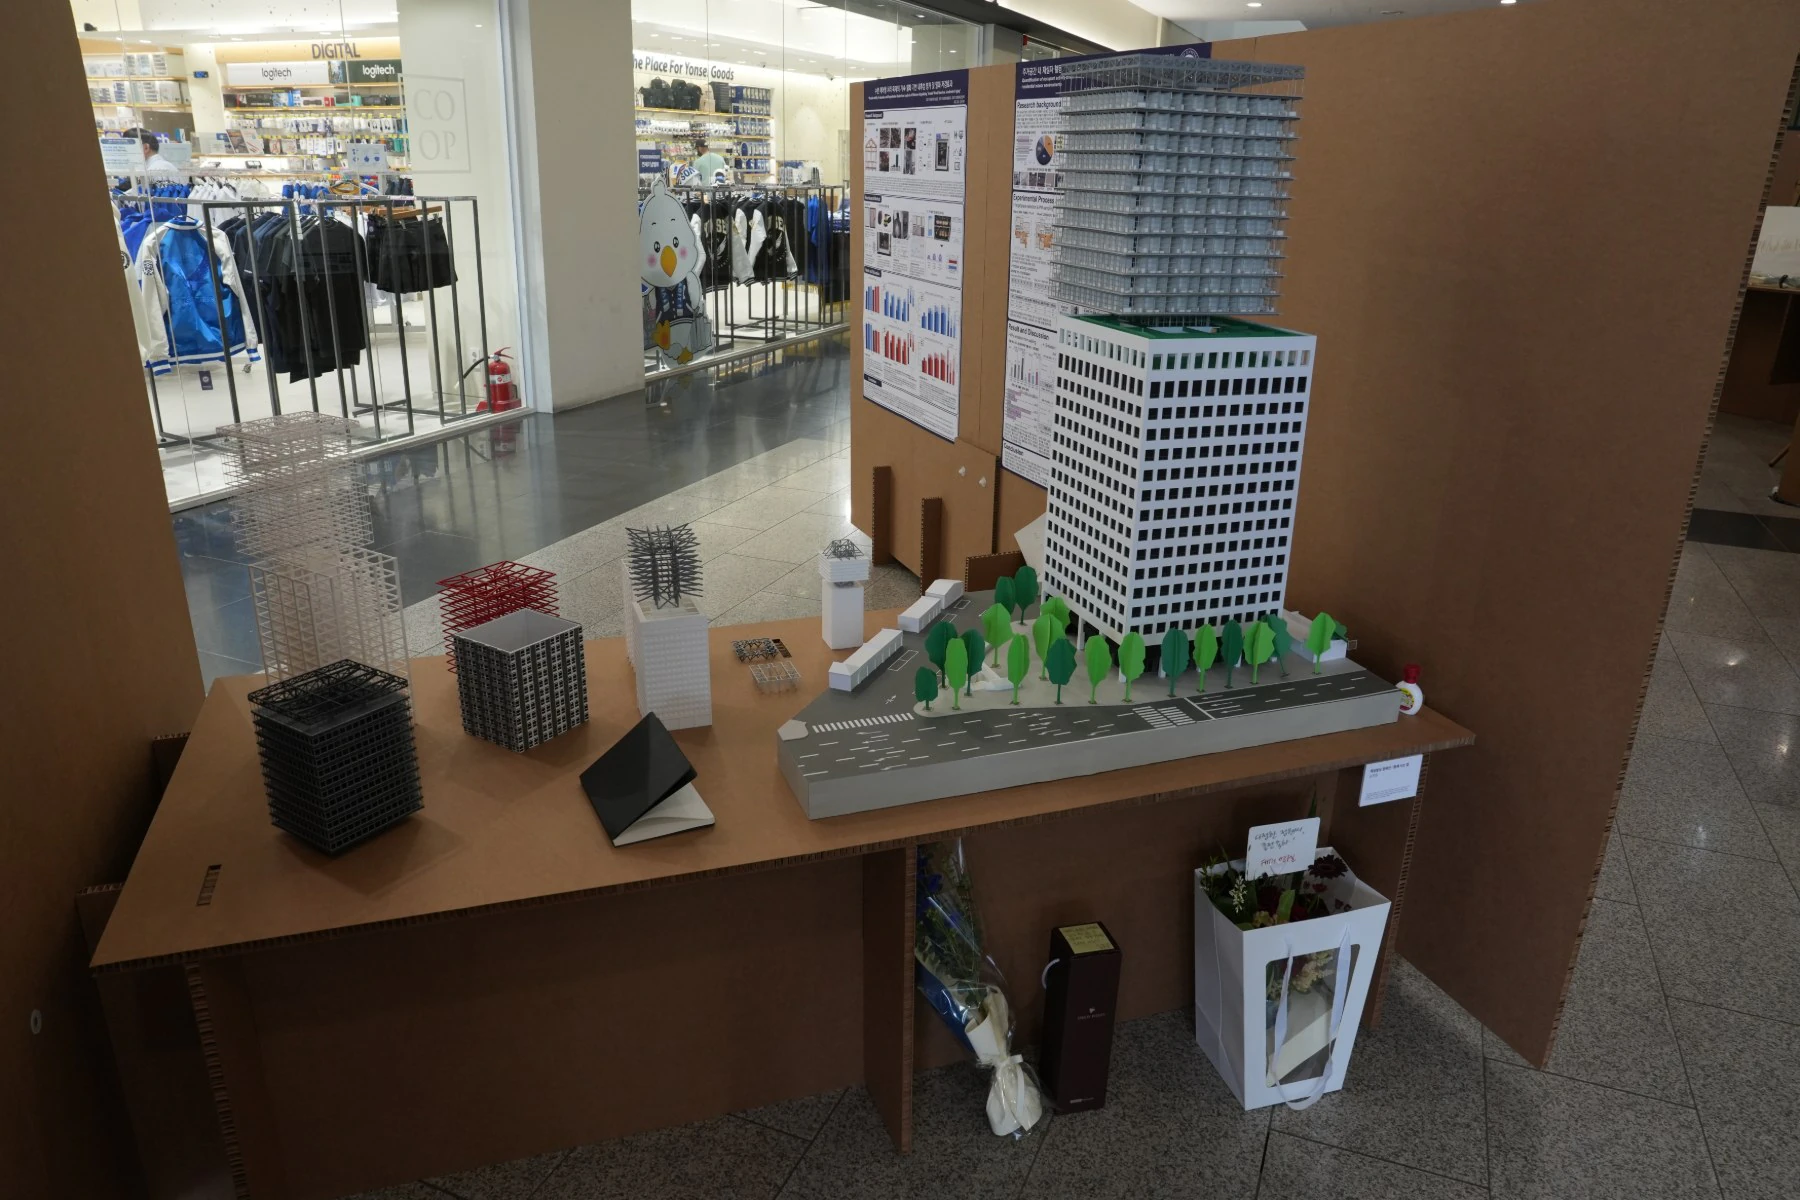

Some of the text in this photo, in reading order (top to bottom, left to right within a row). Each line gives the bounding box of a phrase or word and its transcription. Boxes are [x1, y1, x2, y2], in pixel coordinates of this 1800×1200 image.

[312, 43, 360, 59] DIGITAL
[262, 67, 292, 80] logitech
[362, 64, 395, 79] logitech
[645, 56, 667, 72] Place
[670, 60, 683, 74] For
[711, 66, 734, 80] Goods
[413, 89, 455, 122] CO
[1017, 100, 1062, 109] Research background
[418, 129, 456, 160] OP
[1013, 194, 1037, 203] Experimental
[1028, 328, 1050, 340] Discussion
